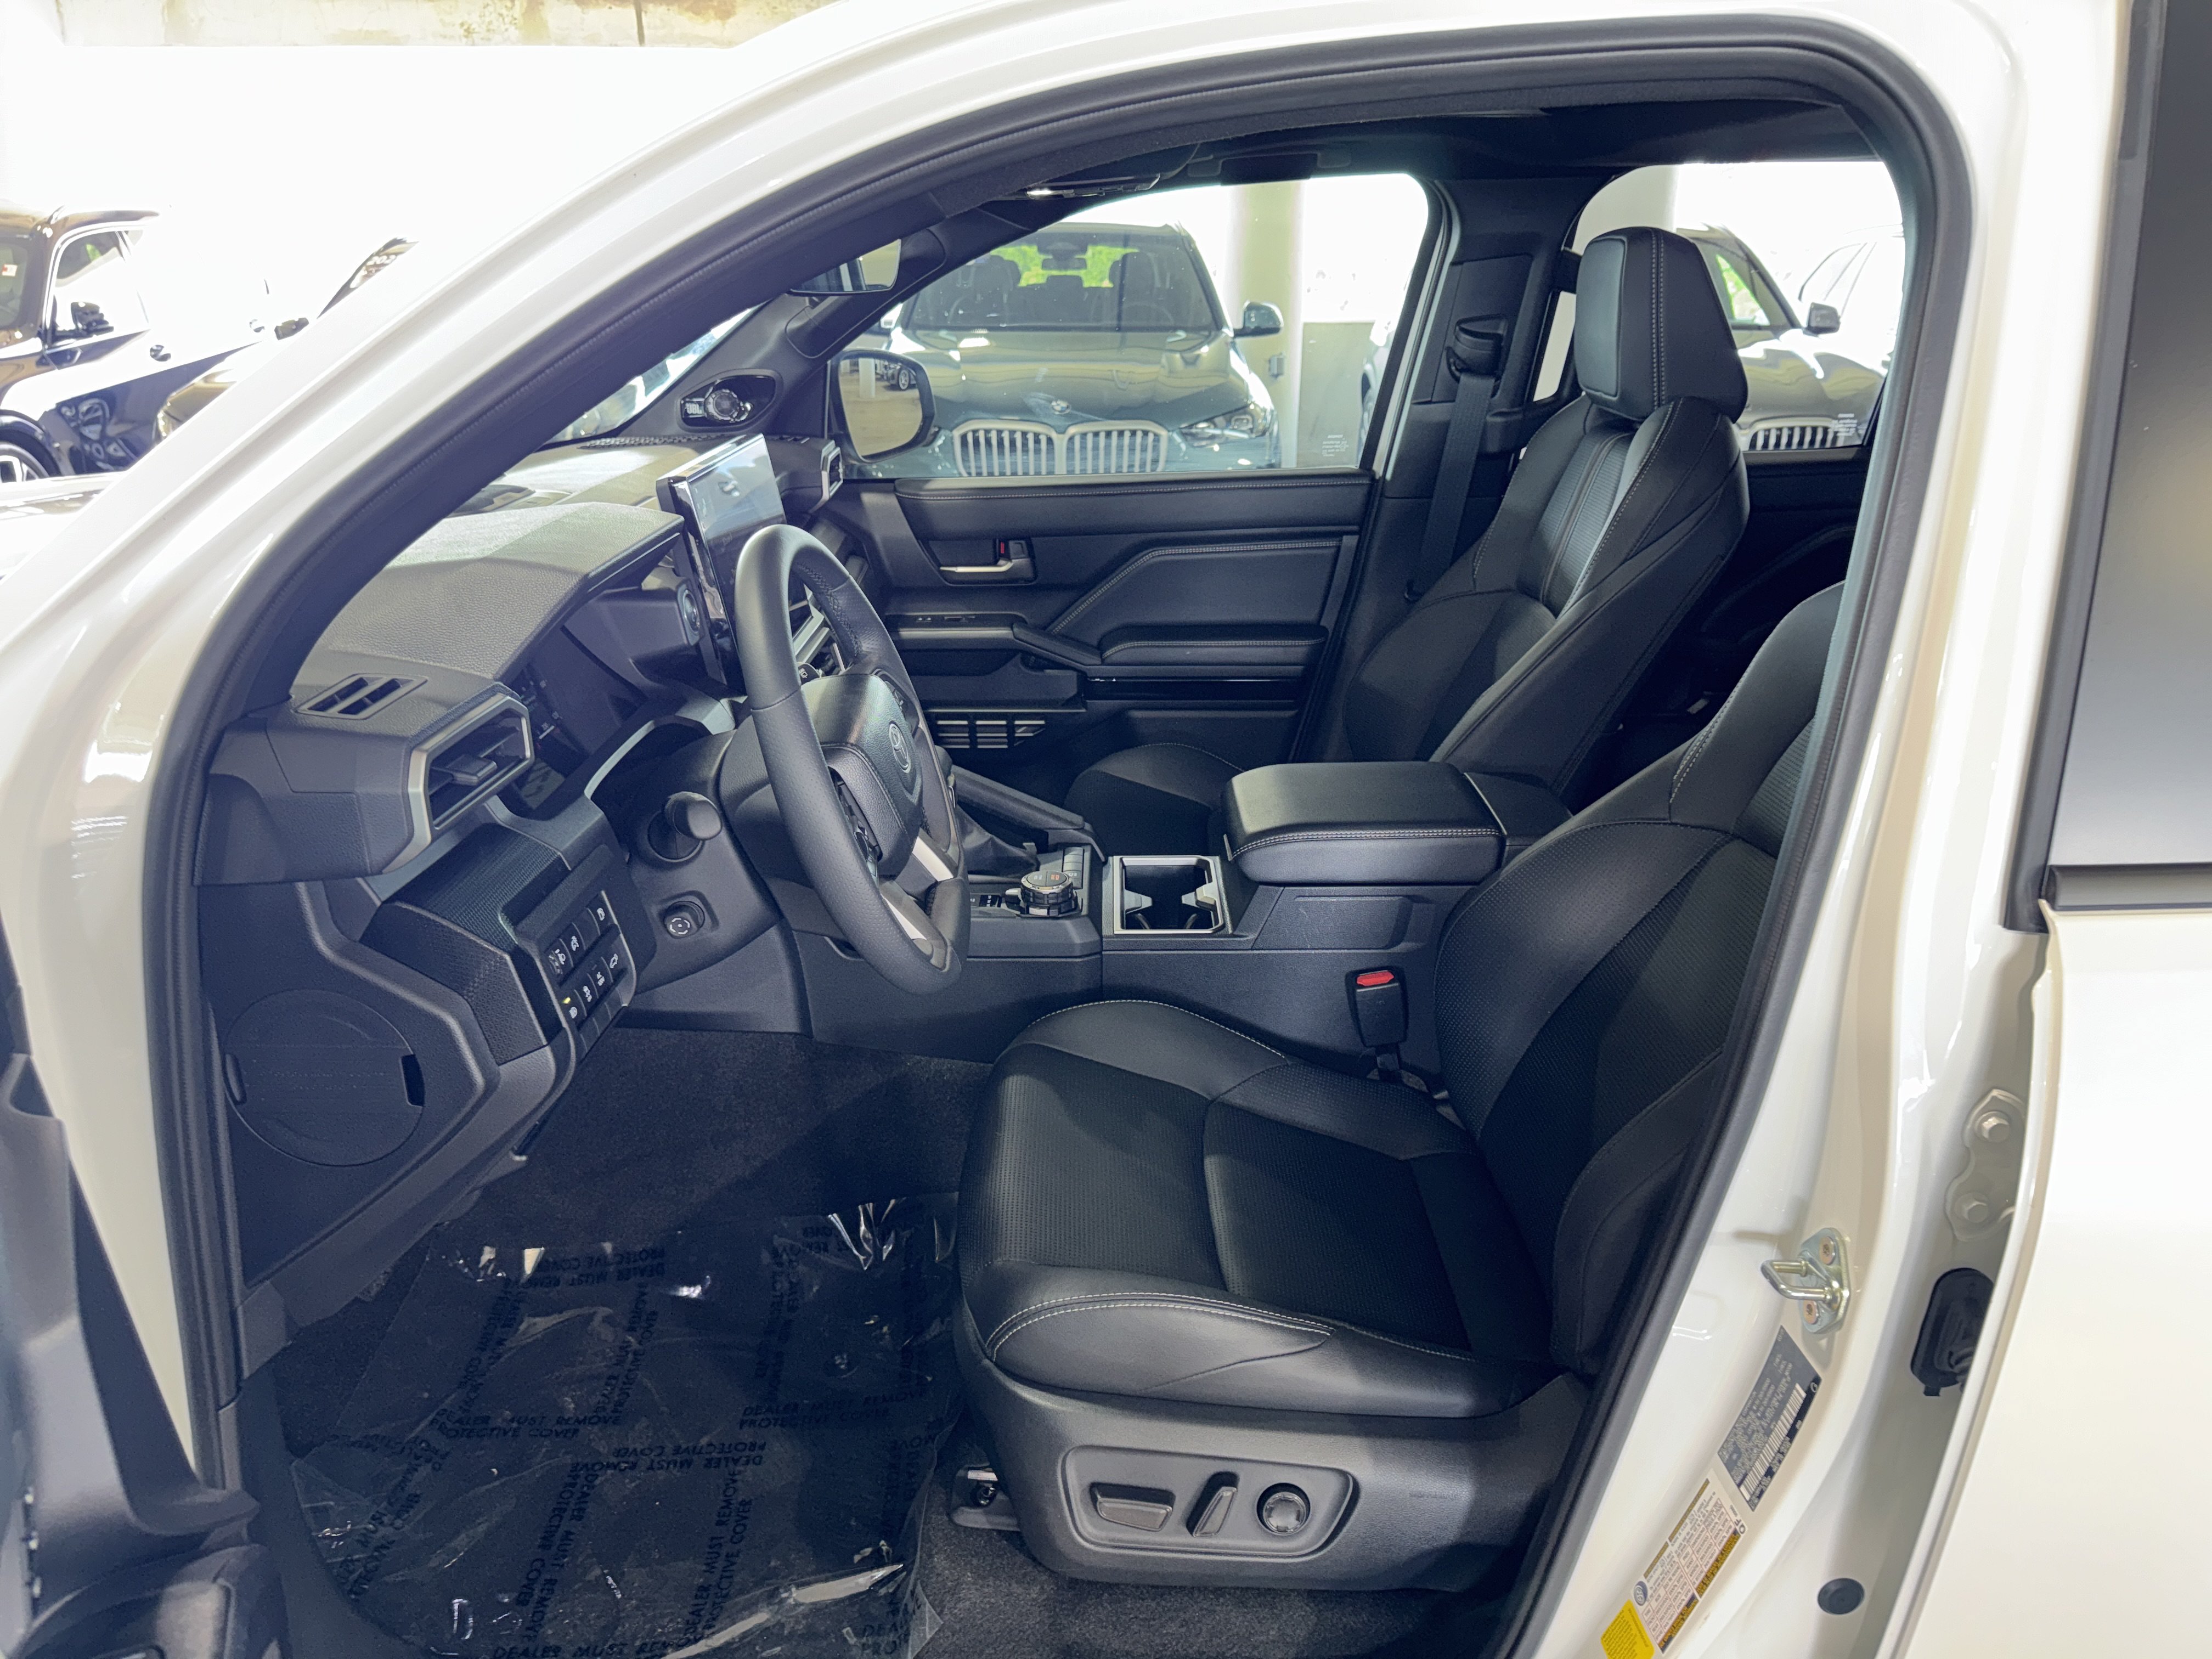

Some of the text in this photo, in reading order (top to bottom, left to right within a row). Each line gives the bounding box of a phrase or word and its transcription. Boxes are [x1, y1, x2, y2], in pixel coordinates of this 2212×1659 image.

[686, 403, 702, 414] JBL
[556, 1414, 622, 1426] REMOVE
[528, 1427, 580, 1440] COVER
[613, 1441, 766, 1458] PROTECTIVE COVER
[646, 1458, 695, 1471] MUST
[703, 1455, 764, 1470] DEALER
[702, 1535, 725, 1575] MUST
[715, 1466, 742, 1527] REMOVE
[730, 1498, 753, 1545] COVER
[493, 1645, 562, 1658] DEALER
